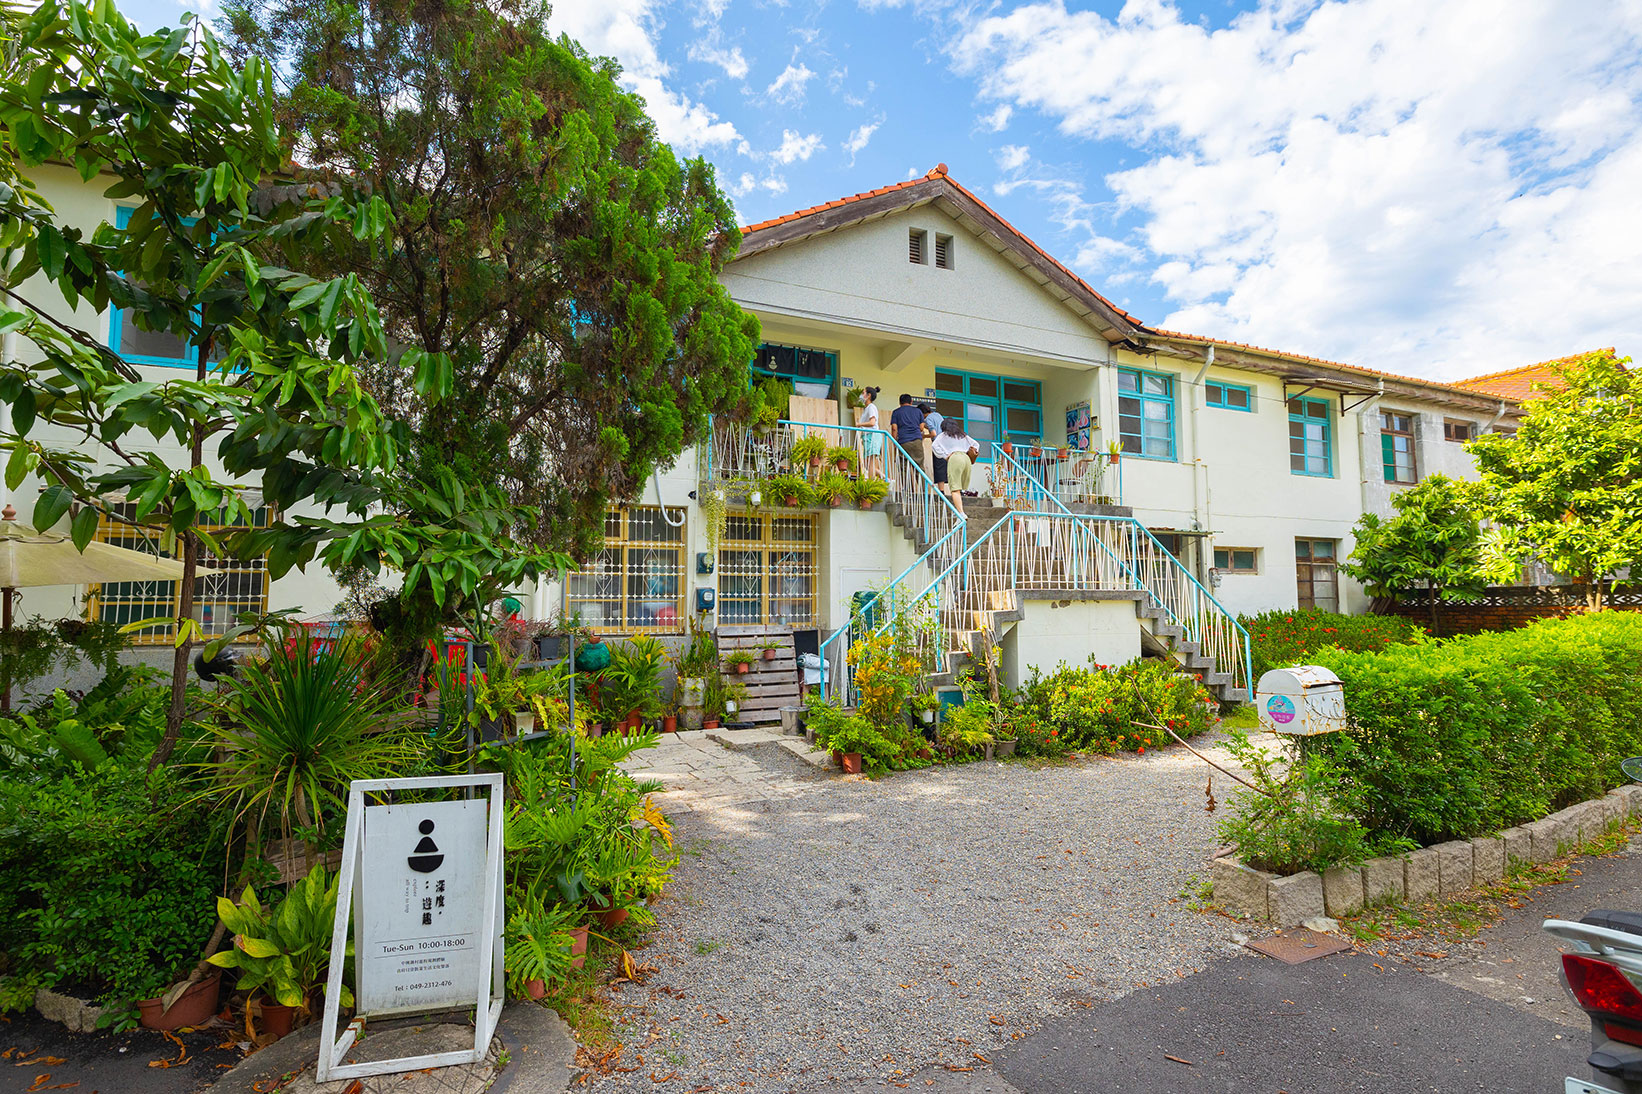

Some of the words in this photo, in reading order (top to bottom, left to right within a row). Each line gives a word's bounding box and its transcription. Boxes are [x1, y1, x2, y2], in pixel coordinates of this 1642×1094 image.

[383, 944, 414, 953] Tue-Sun
[418, 938, 465, 949] 10:00-18:00
[409, 980, 452, 991] 049-2312-476
